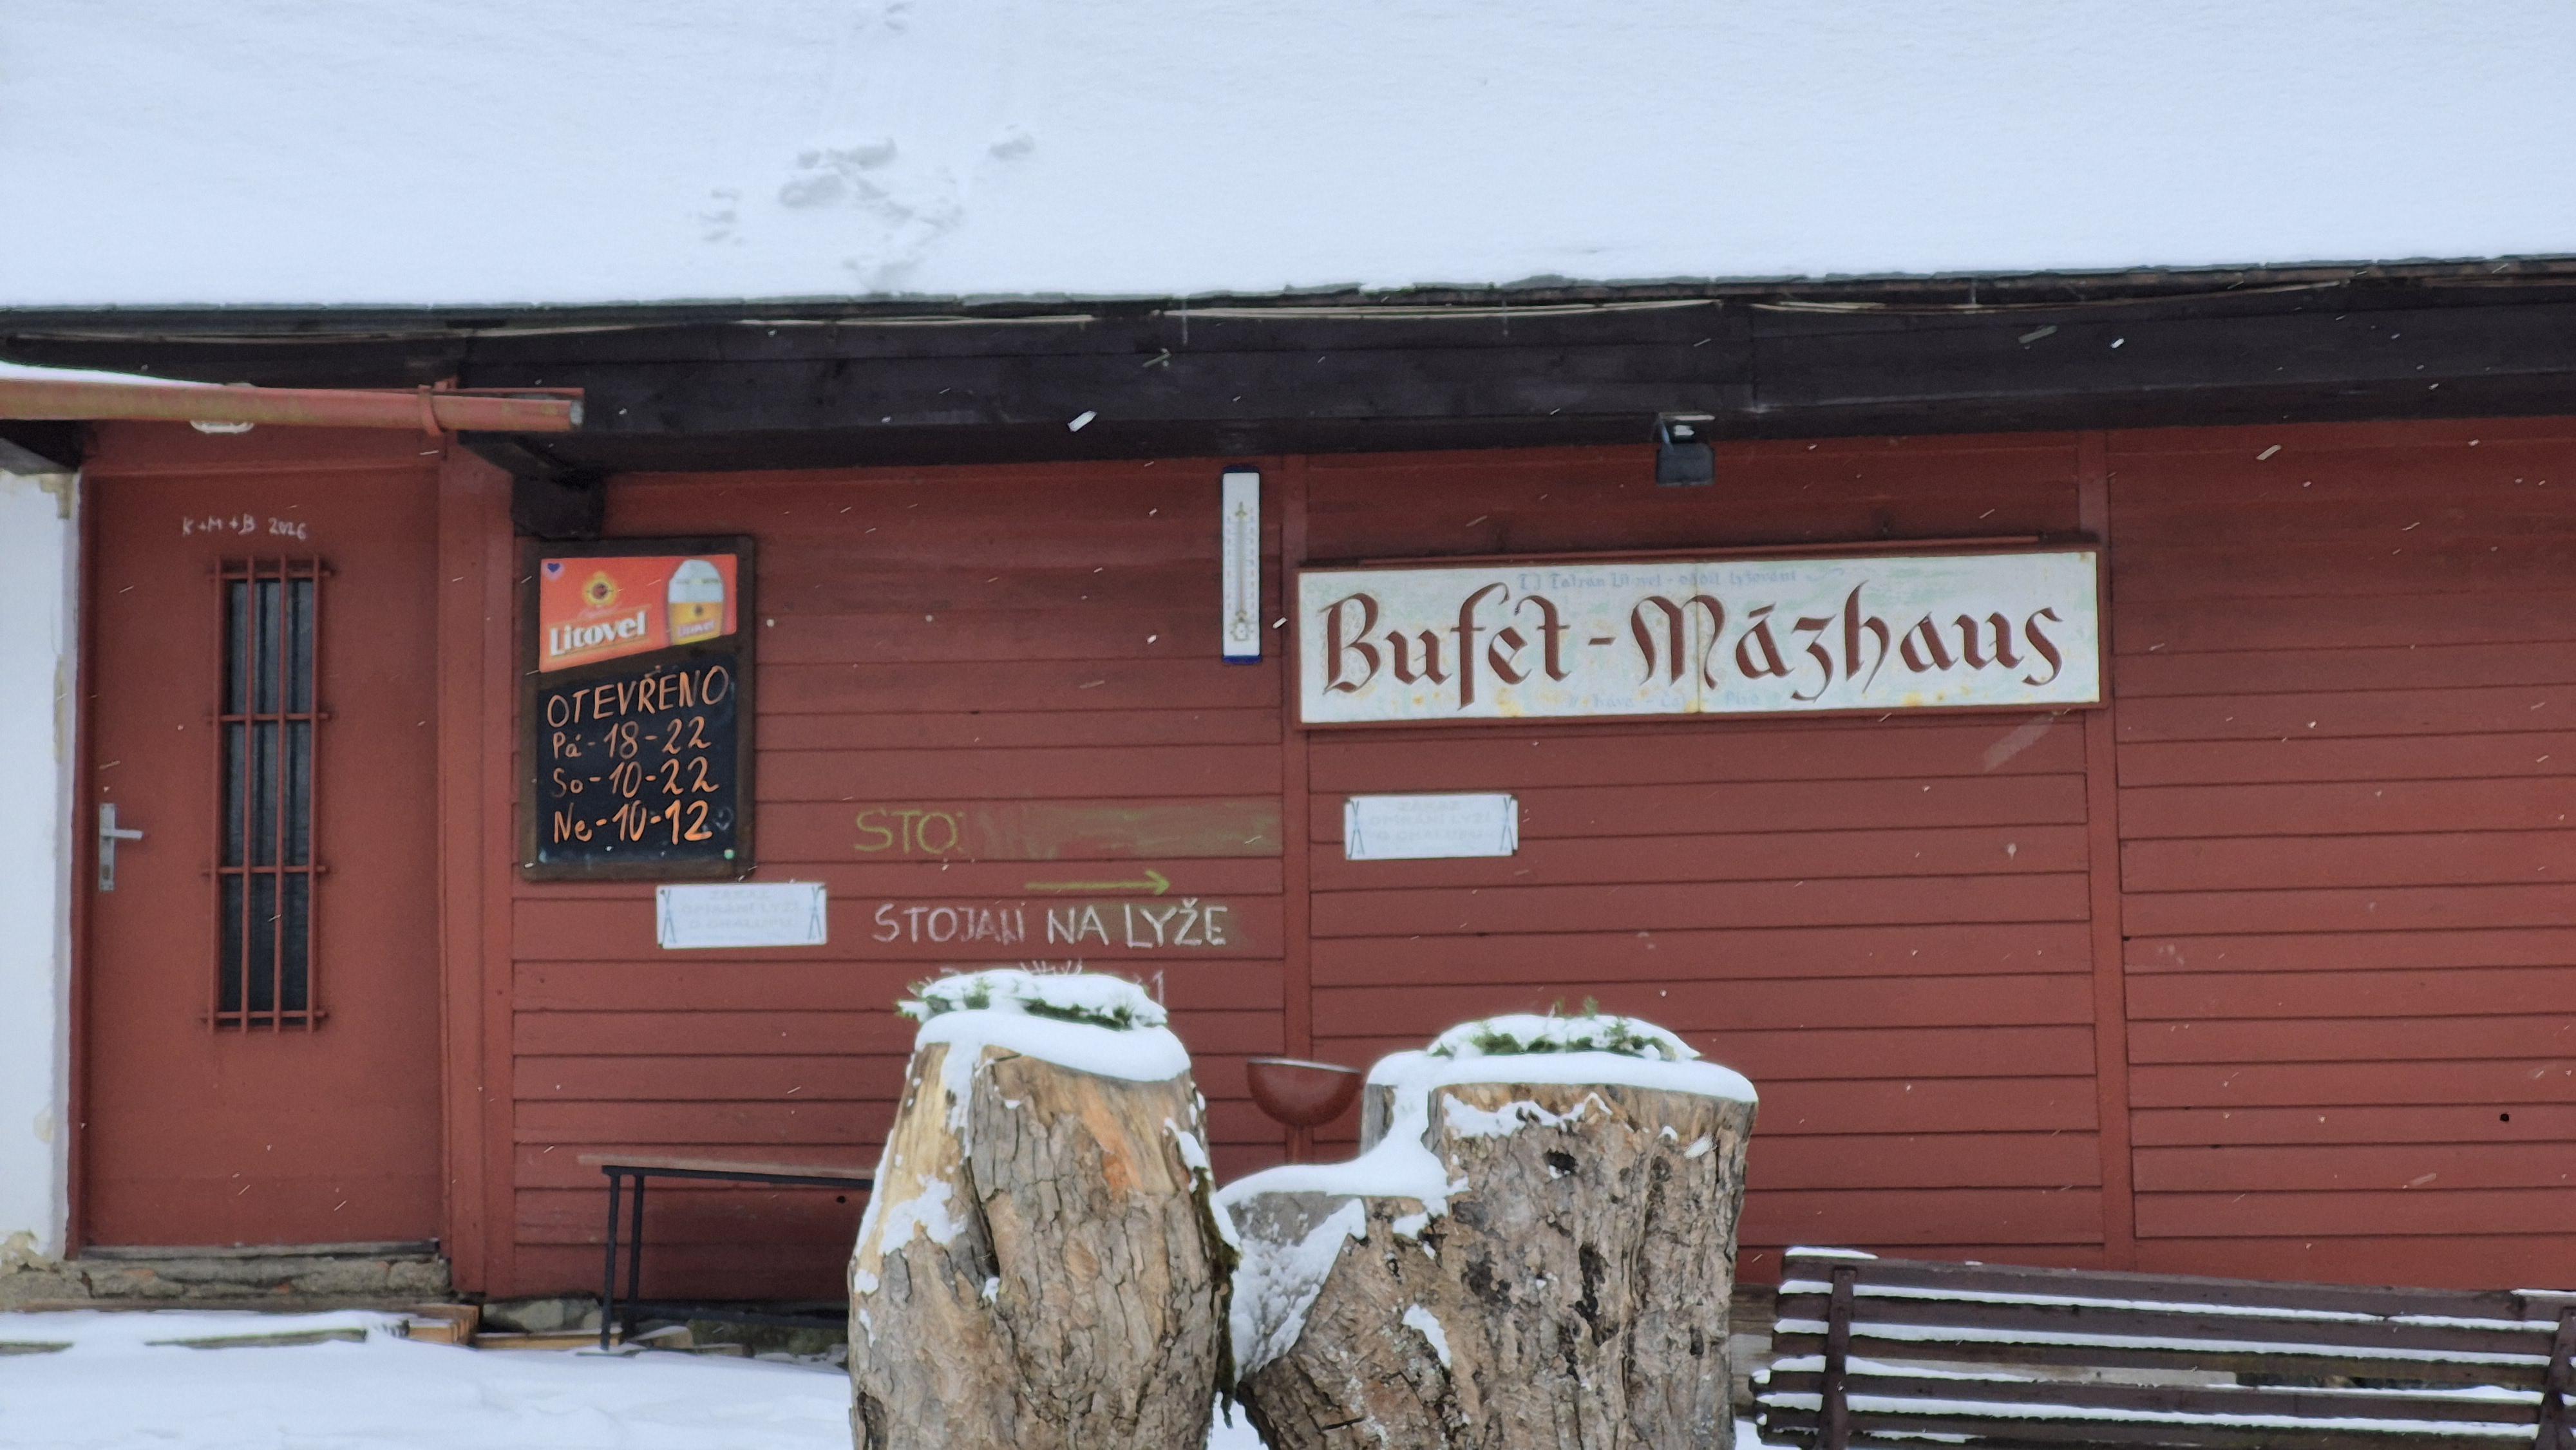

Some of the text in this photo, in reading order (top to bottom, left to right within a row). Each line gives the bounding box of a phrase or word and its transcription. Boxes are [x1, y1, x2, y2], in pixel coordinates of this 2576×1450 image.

[268, 517, 306, 541] 2026
[550, 609, 647, 657] Litovel
[547, 664, 730, 728] OTEVŘENO
[1047, 904, 1110, 946] NA
[1124, 898, 1229, 948] LYŽE
